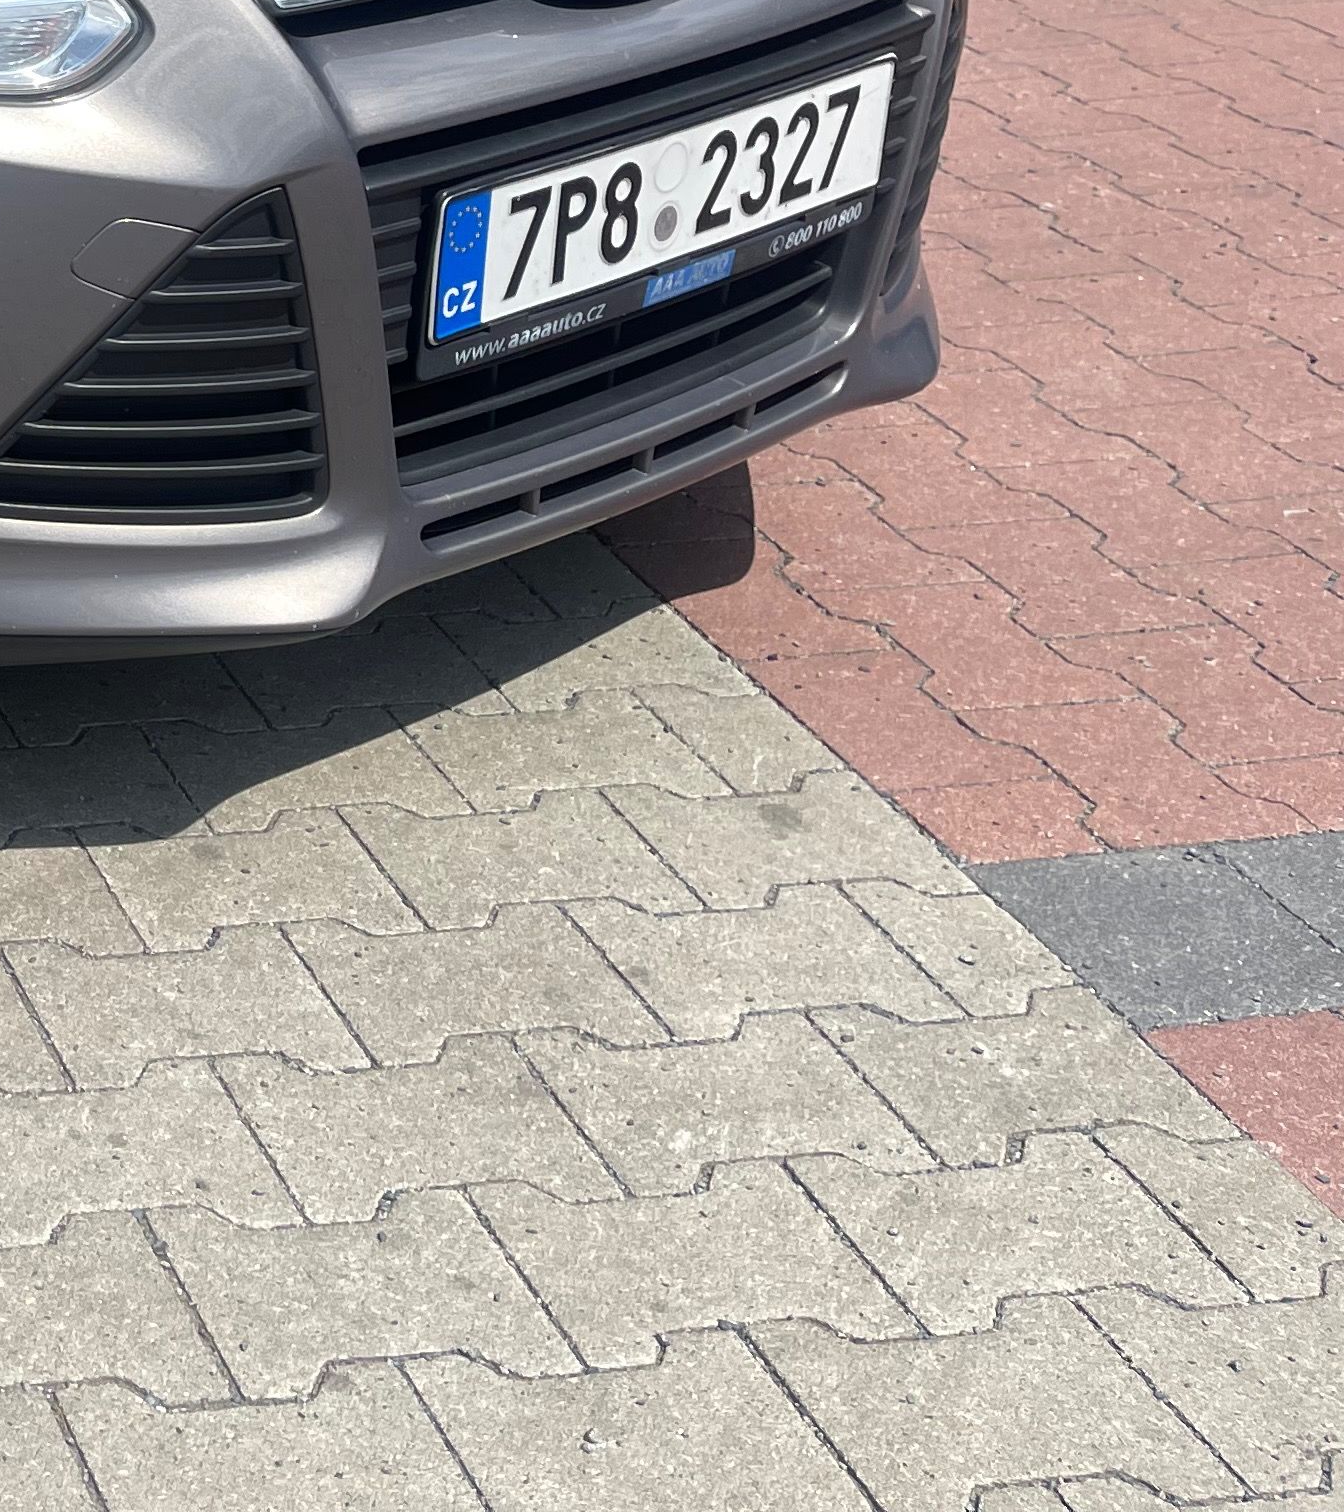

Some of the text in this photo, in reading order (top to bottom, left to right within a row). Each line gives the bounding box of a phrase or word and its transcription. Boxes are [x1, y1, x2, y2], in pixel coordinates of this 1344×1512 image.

[502, 84, 862, 302] 7P8 2327
[784, 201, 862, 251] 800 110 800
[442, 280, 478, 319] CZ
[454, 302, 607, 366] www.aaaauto.cz
